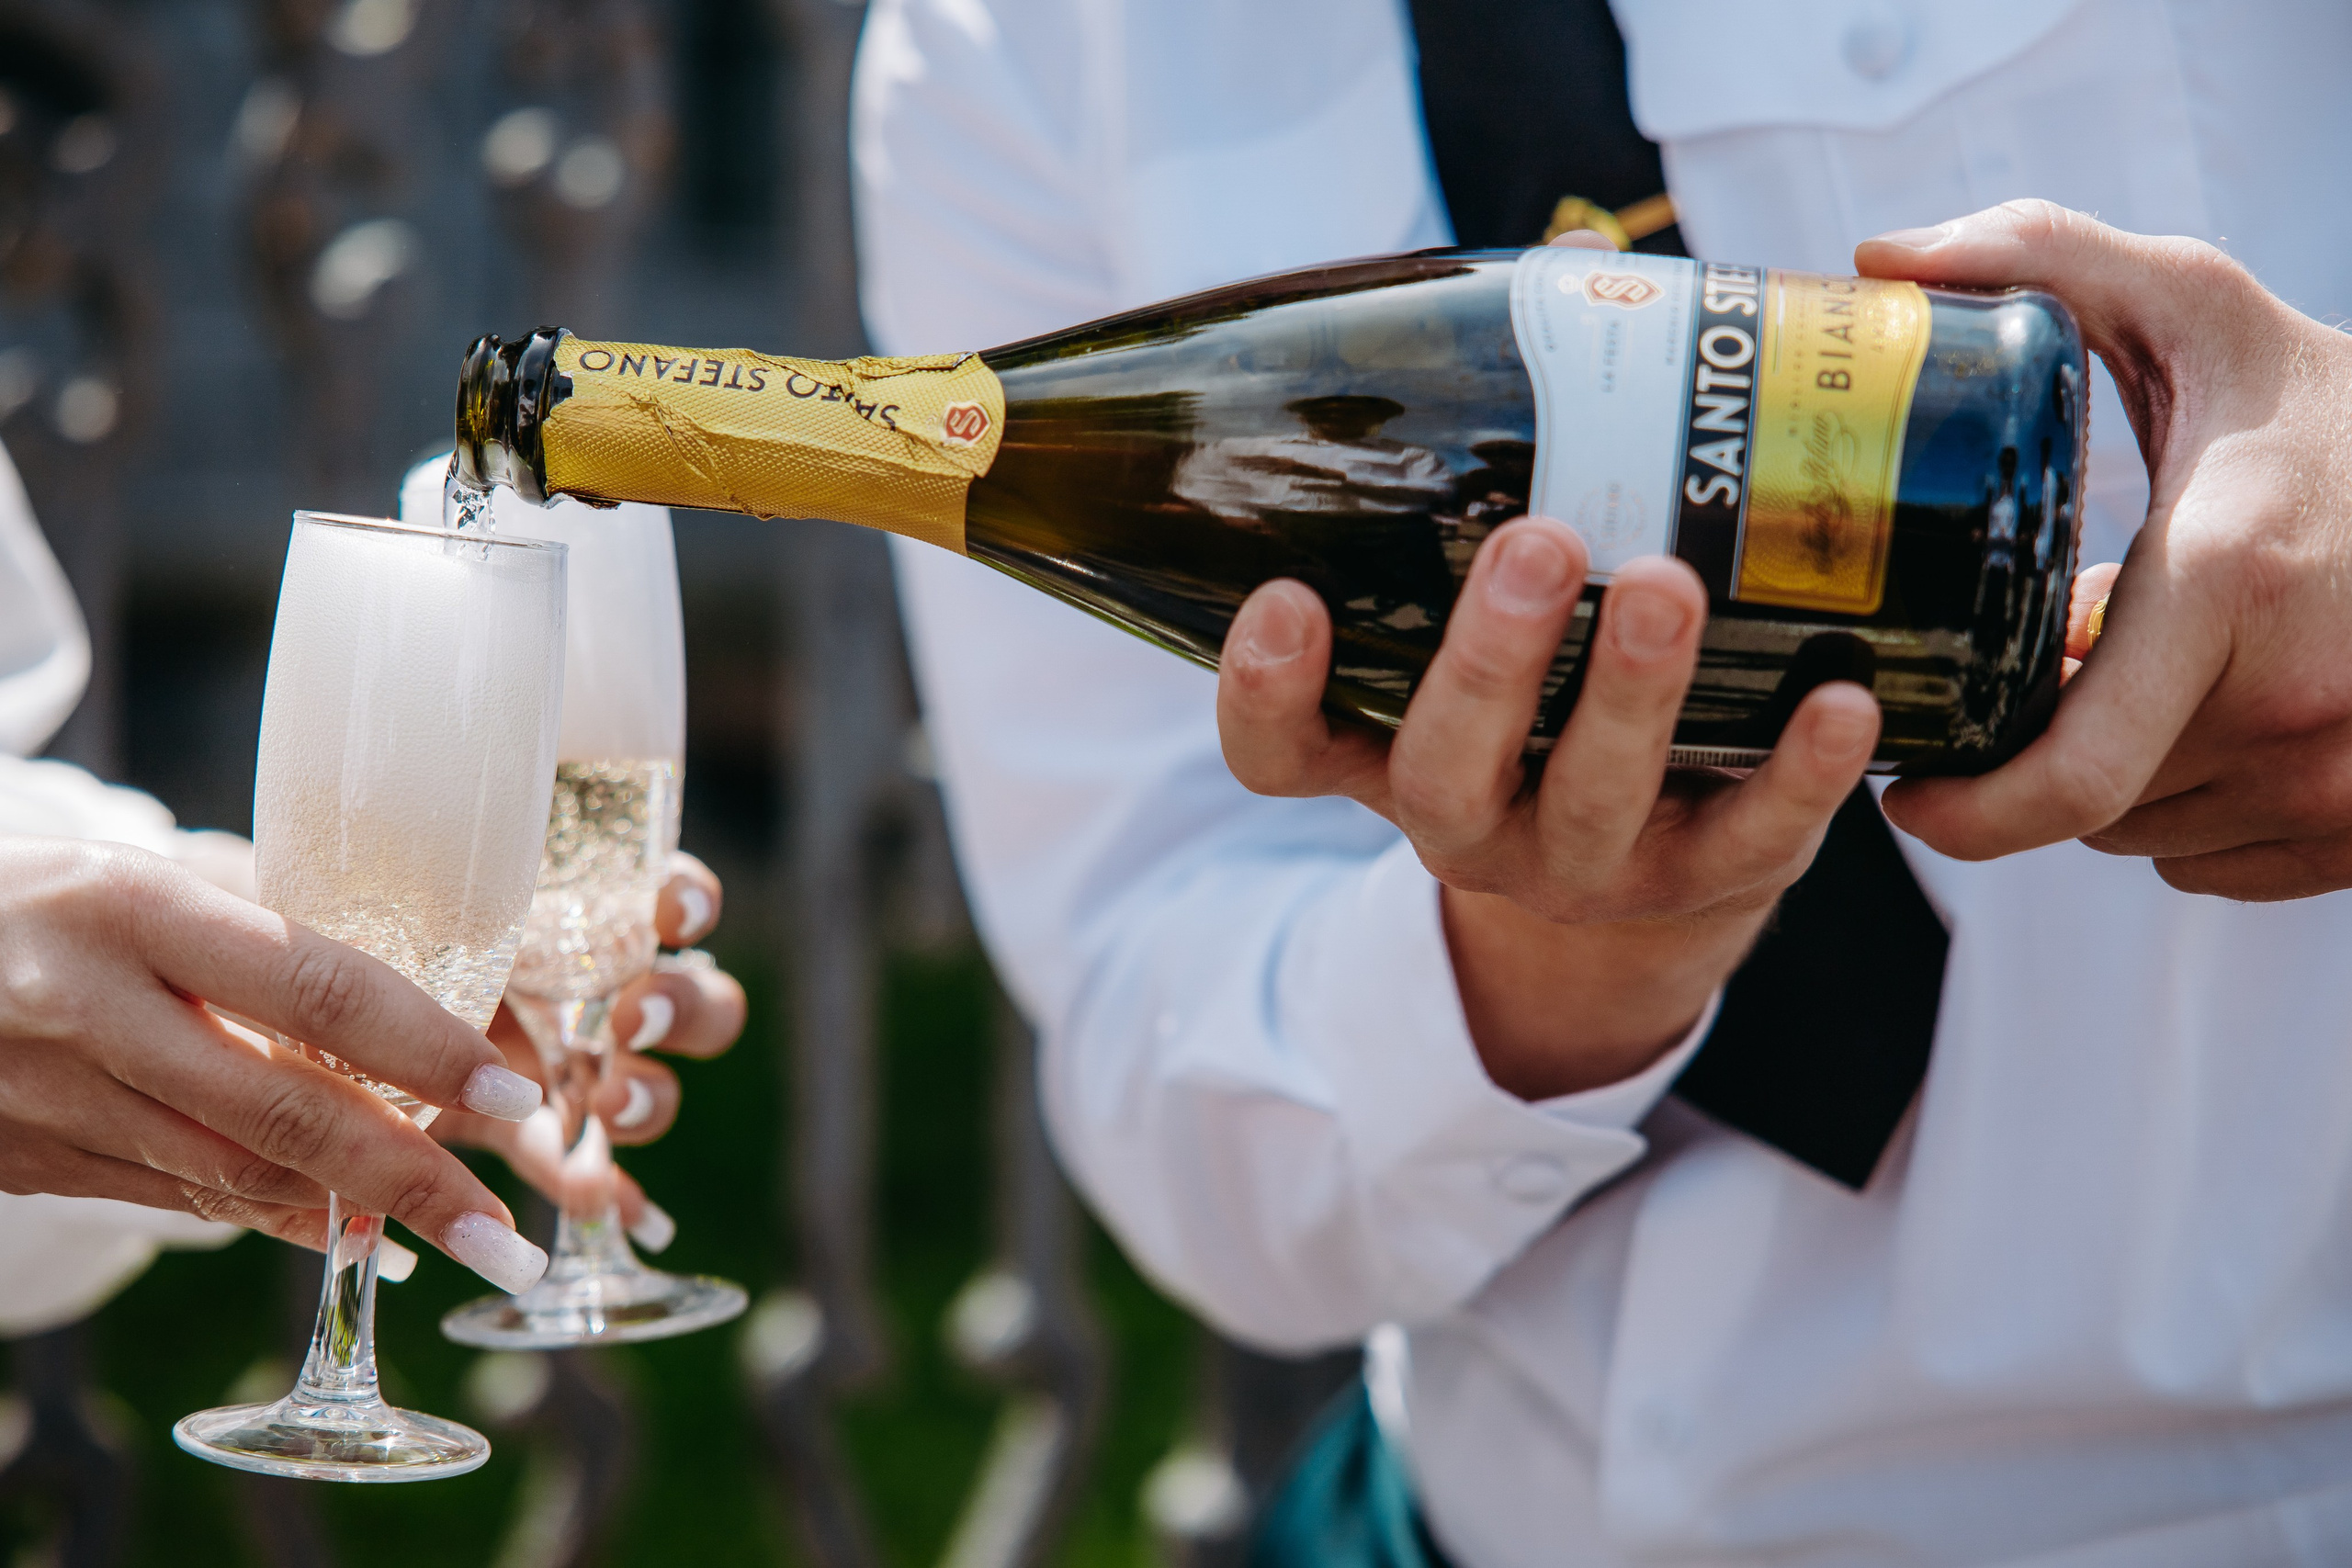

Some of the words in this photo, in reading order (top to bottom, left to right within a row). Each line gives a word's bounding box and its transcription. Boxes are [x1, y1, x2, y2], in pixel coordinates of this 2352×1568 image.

[580, 349, 770, 392] STEFANO
[1815, 274, 1856, 392] BIANC
[1683, 324, 1757, 508] SANTO
